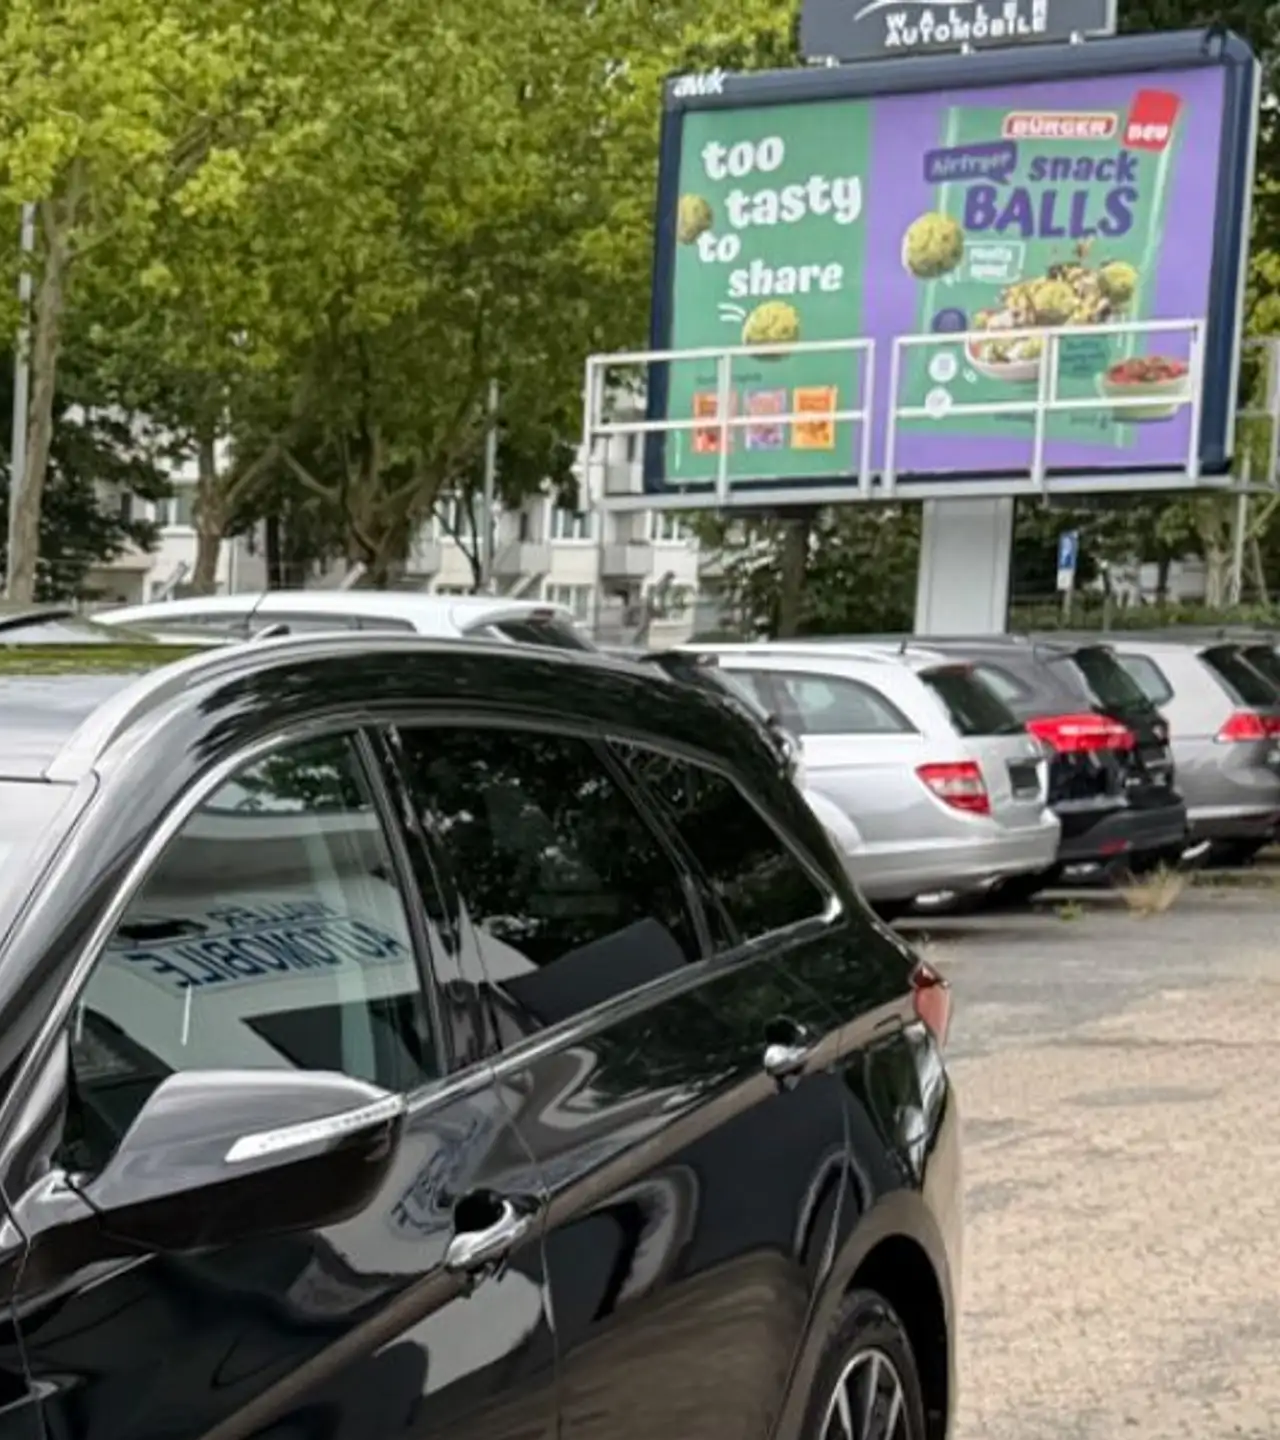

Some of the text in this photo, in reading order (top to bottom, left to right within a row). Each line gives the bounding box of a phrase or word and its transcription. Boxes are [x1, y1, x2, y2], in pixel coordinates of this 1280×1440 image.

[884, 16, 1047, 47] AUTOMOBILE
[885, 0, 1049, 31] WALLER
[1011, 117, 1108, 137] BÜRGER
[1127, 123, 1169, 142] neu
[701, 135, 785, 179] too
[1028, 149, 1140, 183] snack
[724, 174, 862, 226] tasty
[963, 184, 1139, 239] BALLS
[696, 230, 741, 263] to
[727, 258, 843, 299] share
